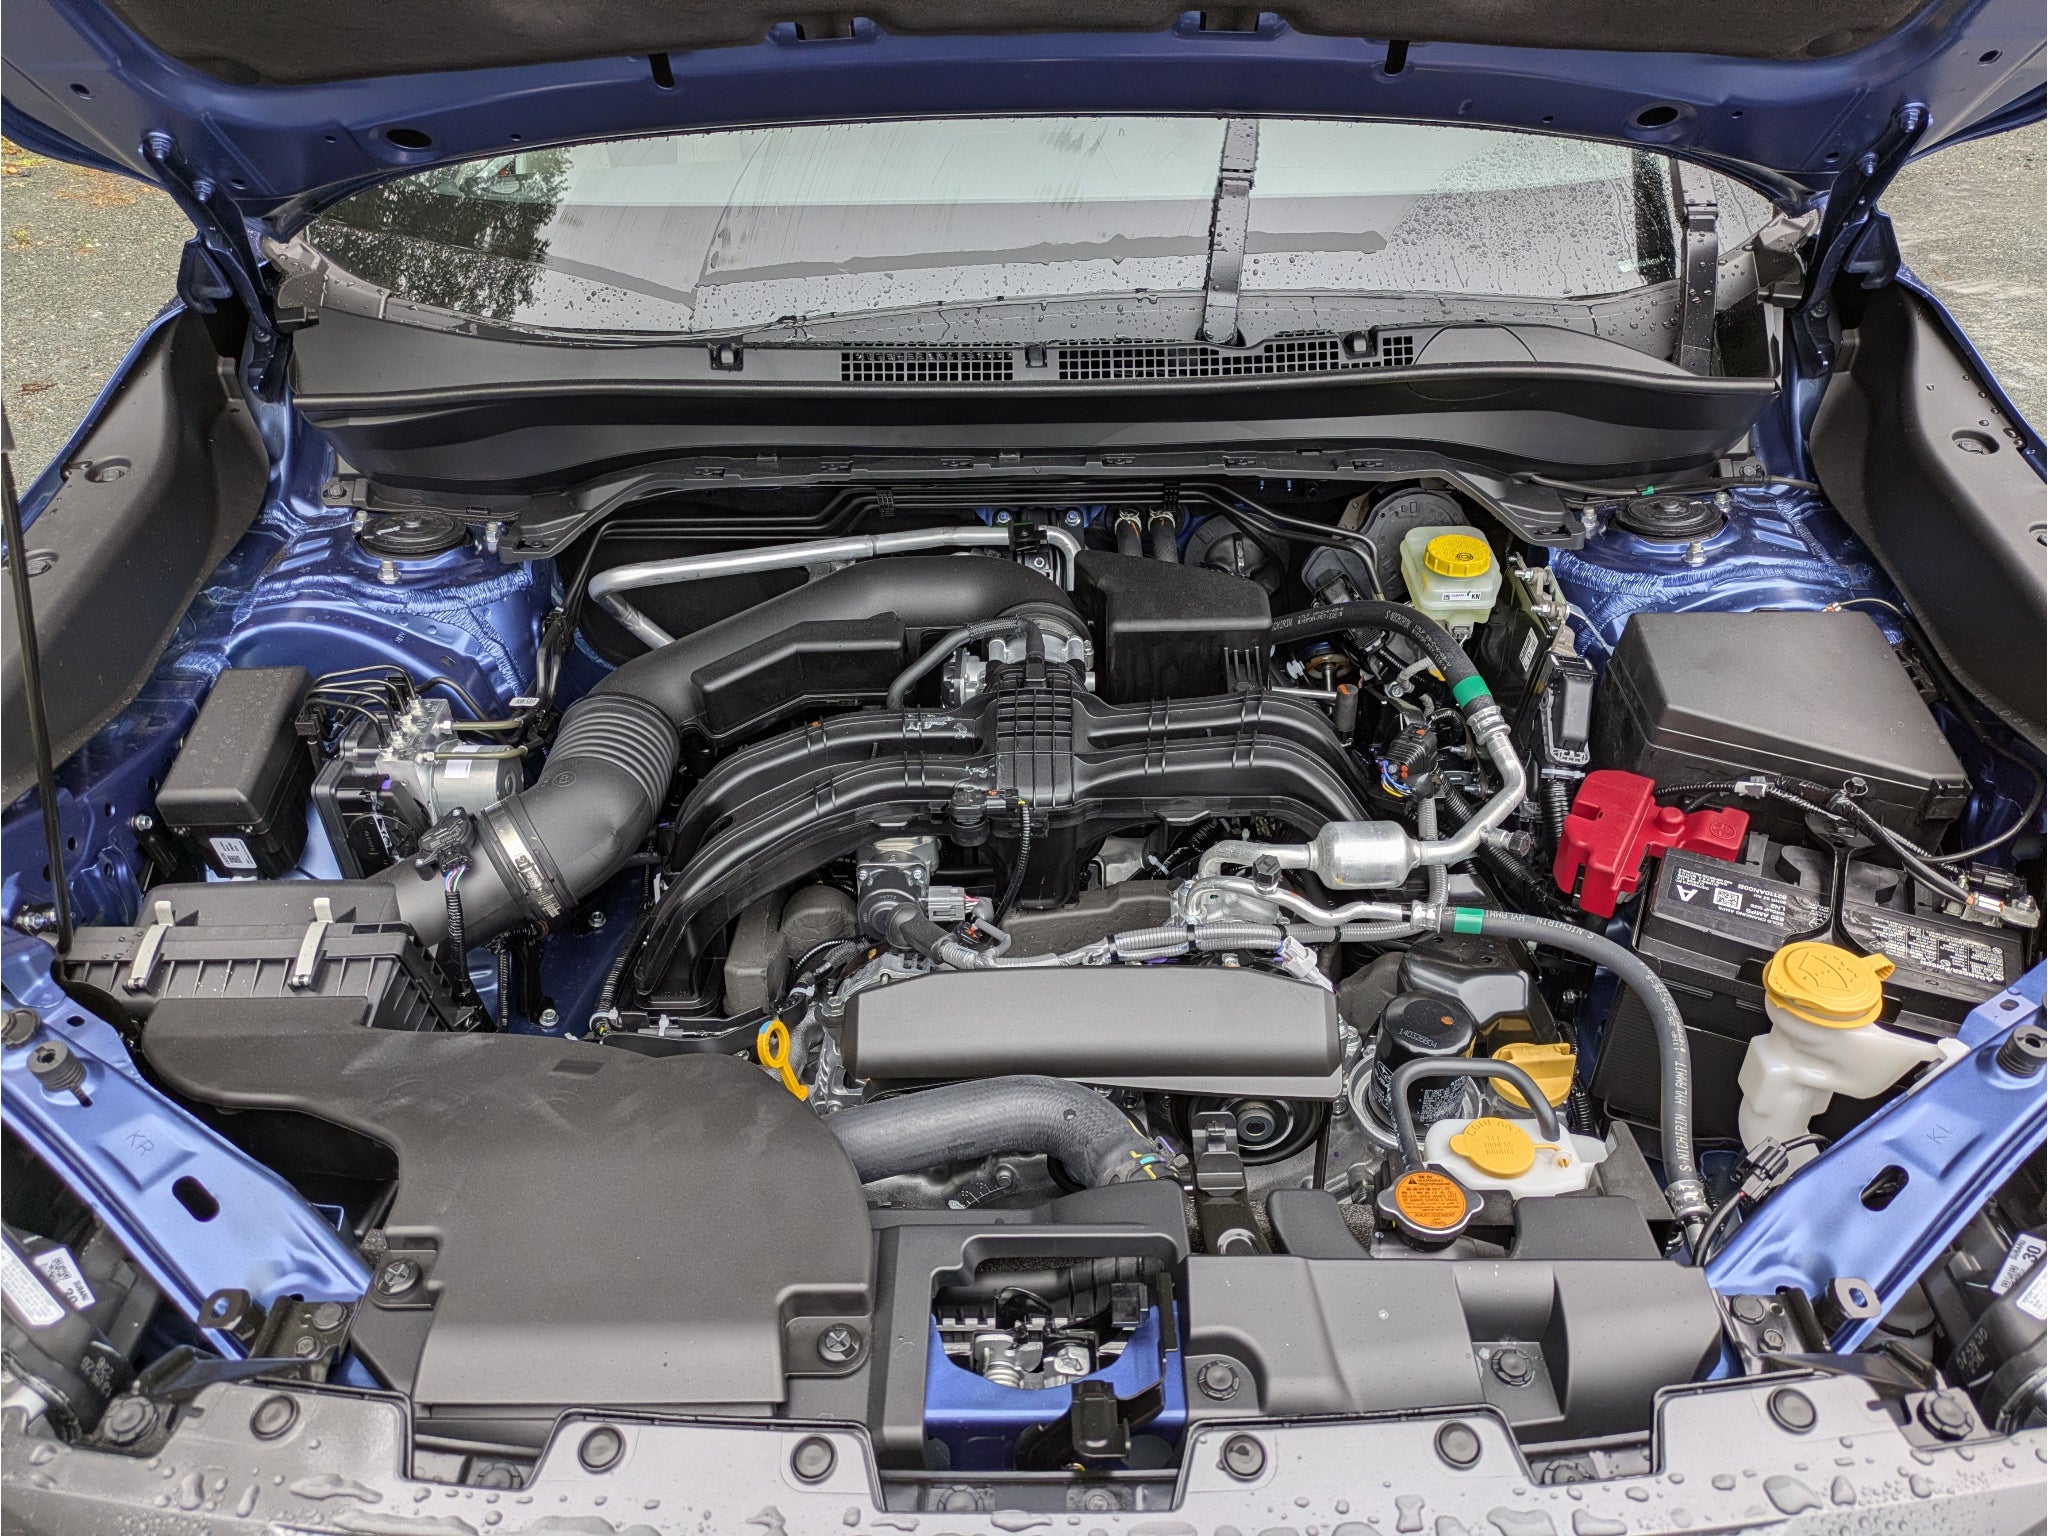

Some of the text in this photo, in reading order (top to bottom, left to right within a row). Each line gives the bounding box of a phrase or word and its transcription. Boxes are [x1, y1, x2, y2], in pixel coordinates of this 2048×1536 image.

[1745, 908, 1769, 918] AMPS
[1770, 904, 1786, 912] LN2
[1767, 919, 1784, 927] COLD
[1926, 1123, 1957, 1146] KL
[124, 1130, 155, 1158] KR
[2022, 1244, 2042, 1263] 30
